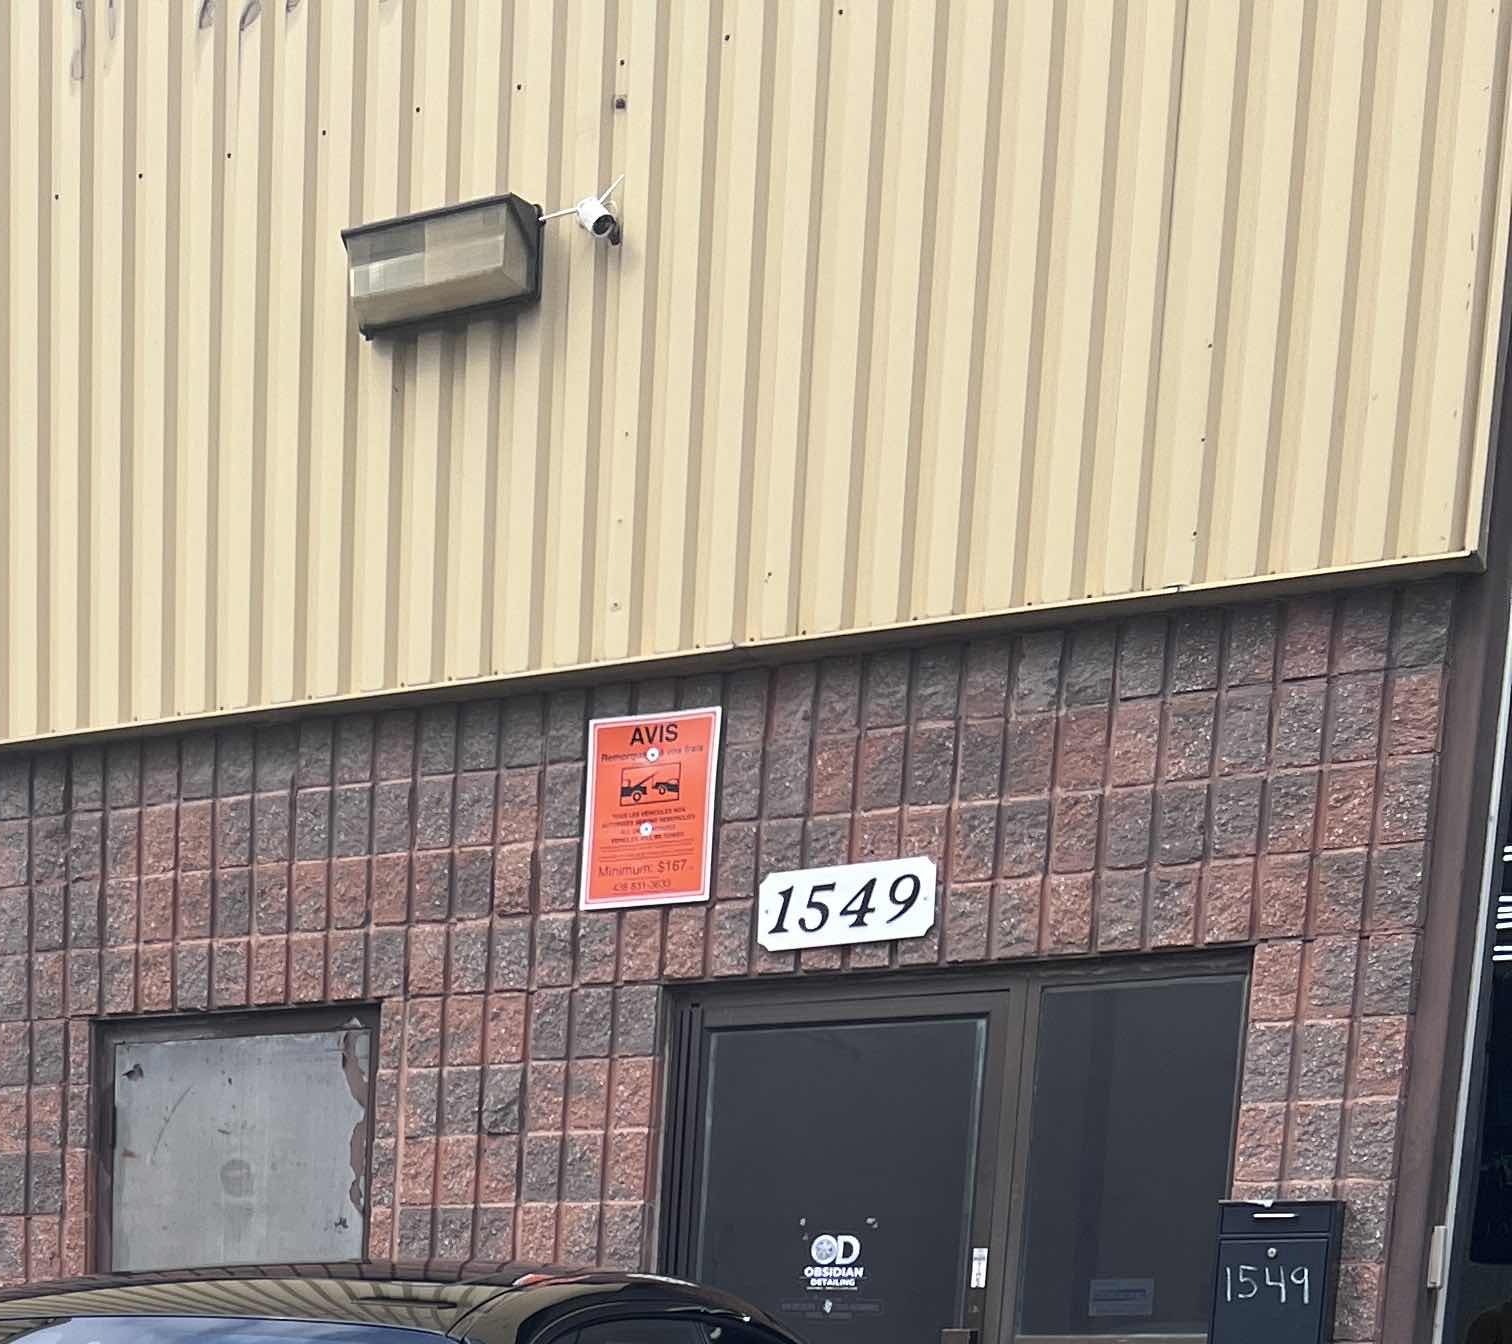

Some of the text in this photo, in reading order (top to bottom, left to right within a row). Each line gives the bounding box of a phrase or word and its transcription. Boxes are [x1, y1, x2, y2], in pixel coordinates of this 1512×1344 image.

[630, 723, 678, 746] AVIS
[598, 863, 654, 877] Minimum:
[768, 873, 921, 934] 1549
[804, 1266, 864, 1278] OBSIDIAN
[810, 1278, 856, 1287] DETAILING
[1225, 1265, 1310, 1304] 1549
